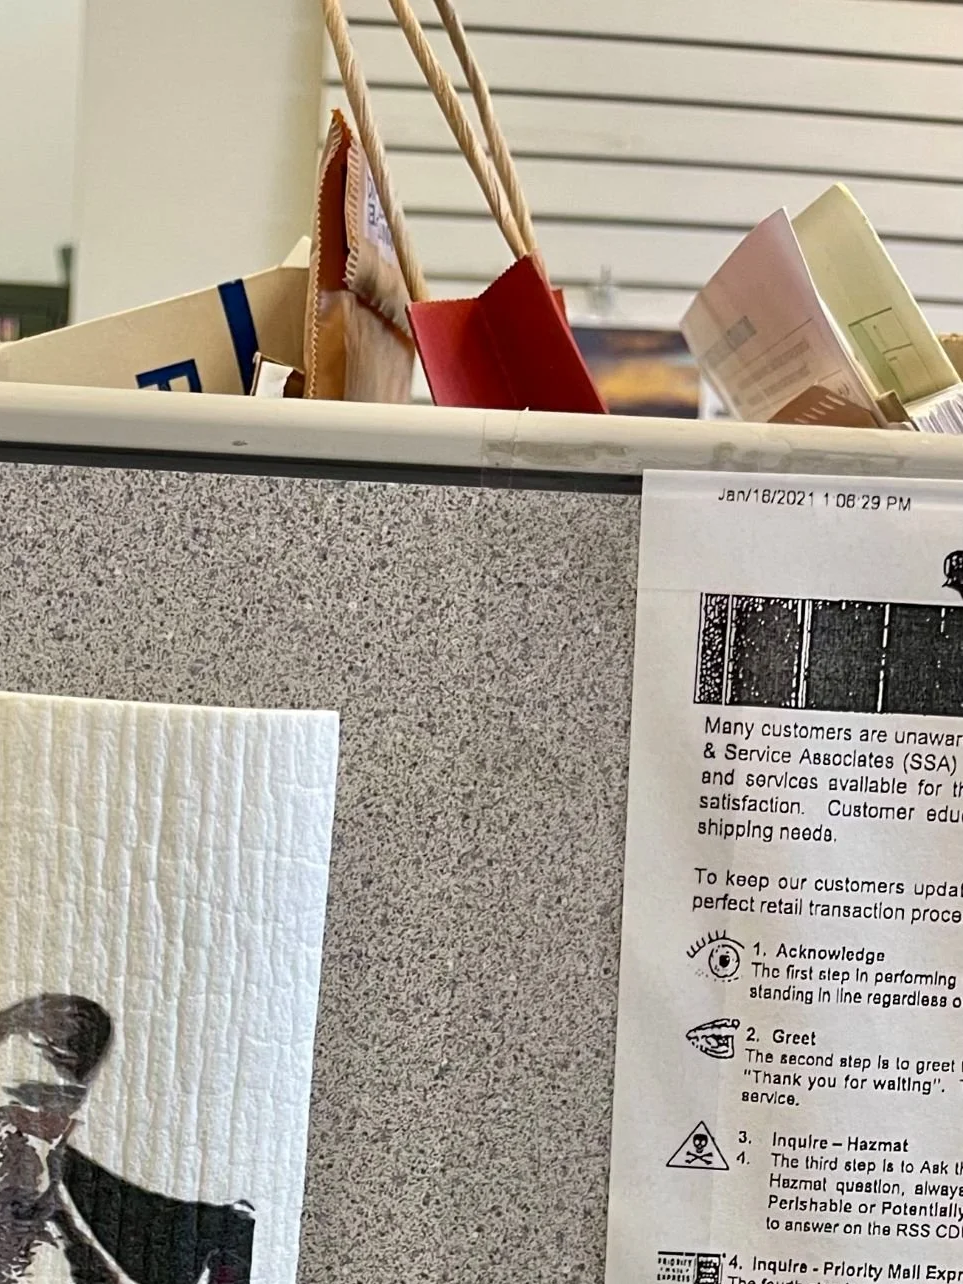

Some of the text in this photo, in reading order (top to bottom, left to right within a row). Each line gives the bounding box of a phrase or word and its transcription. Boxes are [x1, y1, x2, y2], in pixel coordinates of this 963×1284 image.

[886, 496, 912, 511] PM
[705, 716, 963, 747] Many customers are unawar
[704, 742, 957, 777] & Service Associates (SSA)
[702, 768, 942, 796] and services available for
[699, 793, 915, 820] satisfaction. Customer
[698, 818, 836, 843] shipping needs.
[694, 867, 904, 894] To keep our customers
[692, 893, 755, 912] perfect
[760, 898, 802, 915] retail
[809, 900, 904, 920] transaction
[753, 941, 885, 965] 1. Acknowledge
[751, 962, 956, 990] The first step in performing
[746, 1027, 816, 1046] 2. Greet
[744, 1069, 945, 1095] "Thank you for waiting".
[739, 1131, 908, 1152] 3. Inquire Hazmat
[768, 1194, 963, 1222] Perishable or Potentially
[753, 1256, 807, 1275] Inquire
[824, 1261, 883, 1282] Priority
[888, 1264, 920, 1280] Mail
